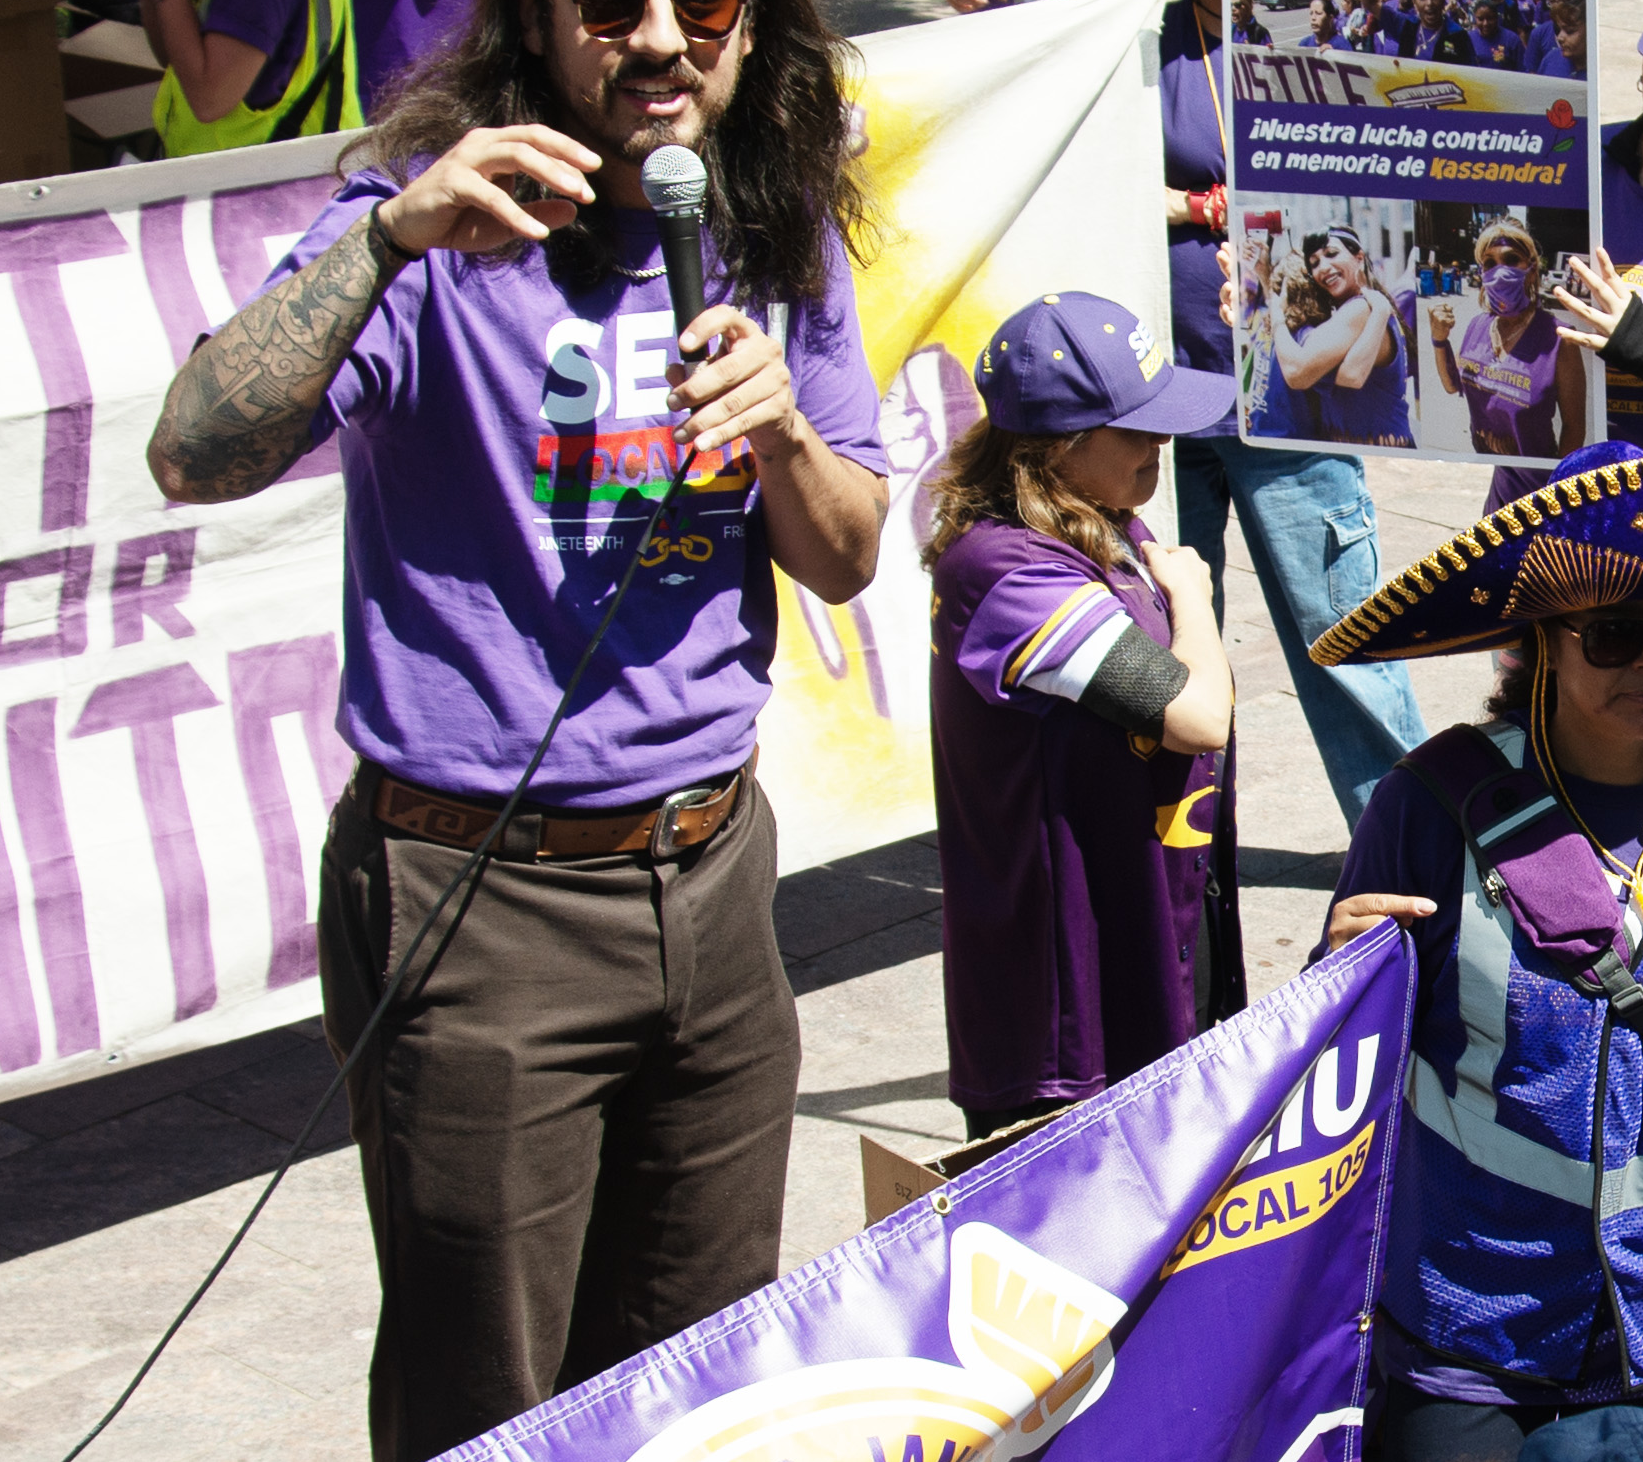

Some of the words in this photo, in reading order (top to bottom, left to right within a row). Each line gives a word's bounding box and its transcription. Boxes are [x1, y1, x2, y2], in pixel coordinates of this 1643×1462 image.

[1251, 117, 1353, 150] ¡Nuestra
[1360, 124, 1426, 152] lucha
[1432, 128, 1544, 157] continúa
[1251, 151, 1281, 173] en
[1285, 153, 1397, 177] memoria
[1401, 155, 1427, 179] de
[1430, 158, 1566, 188] Kassandra!
[545, 430, 708, 501] LOCAL
[1318, 1139, 1371, 1208] 105
